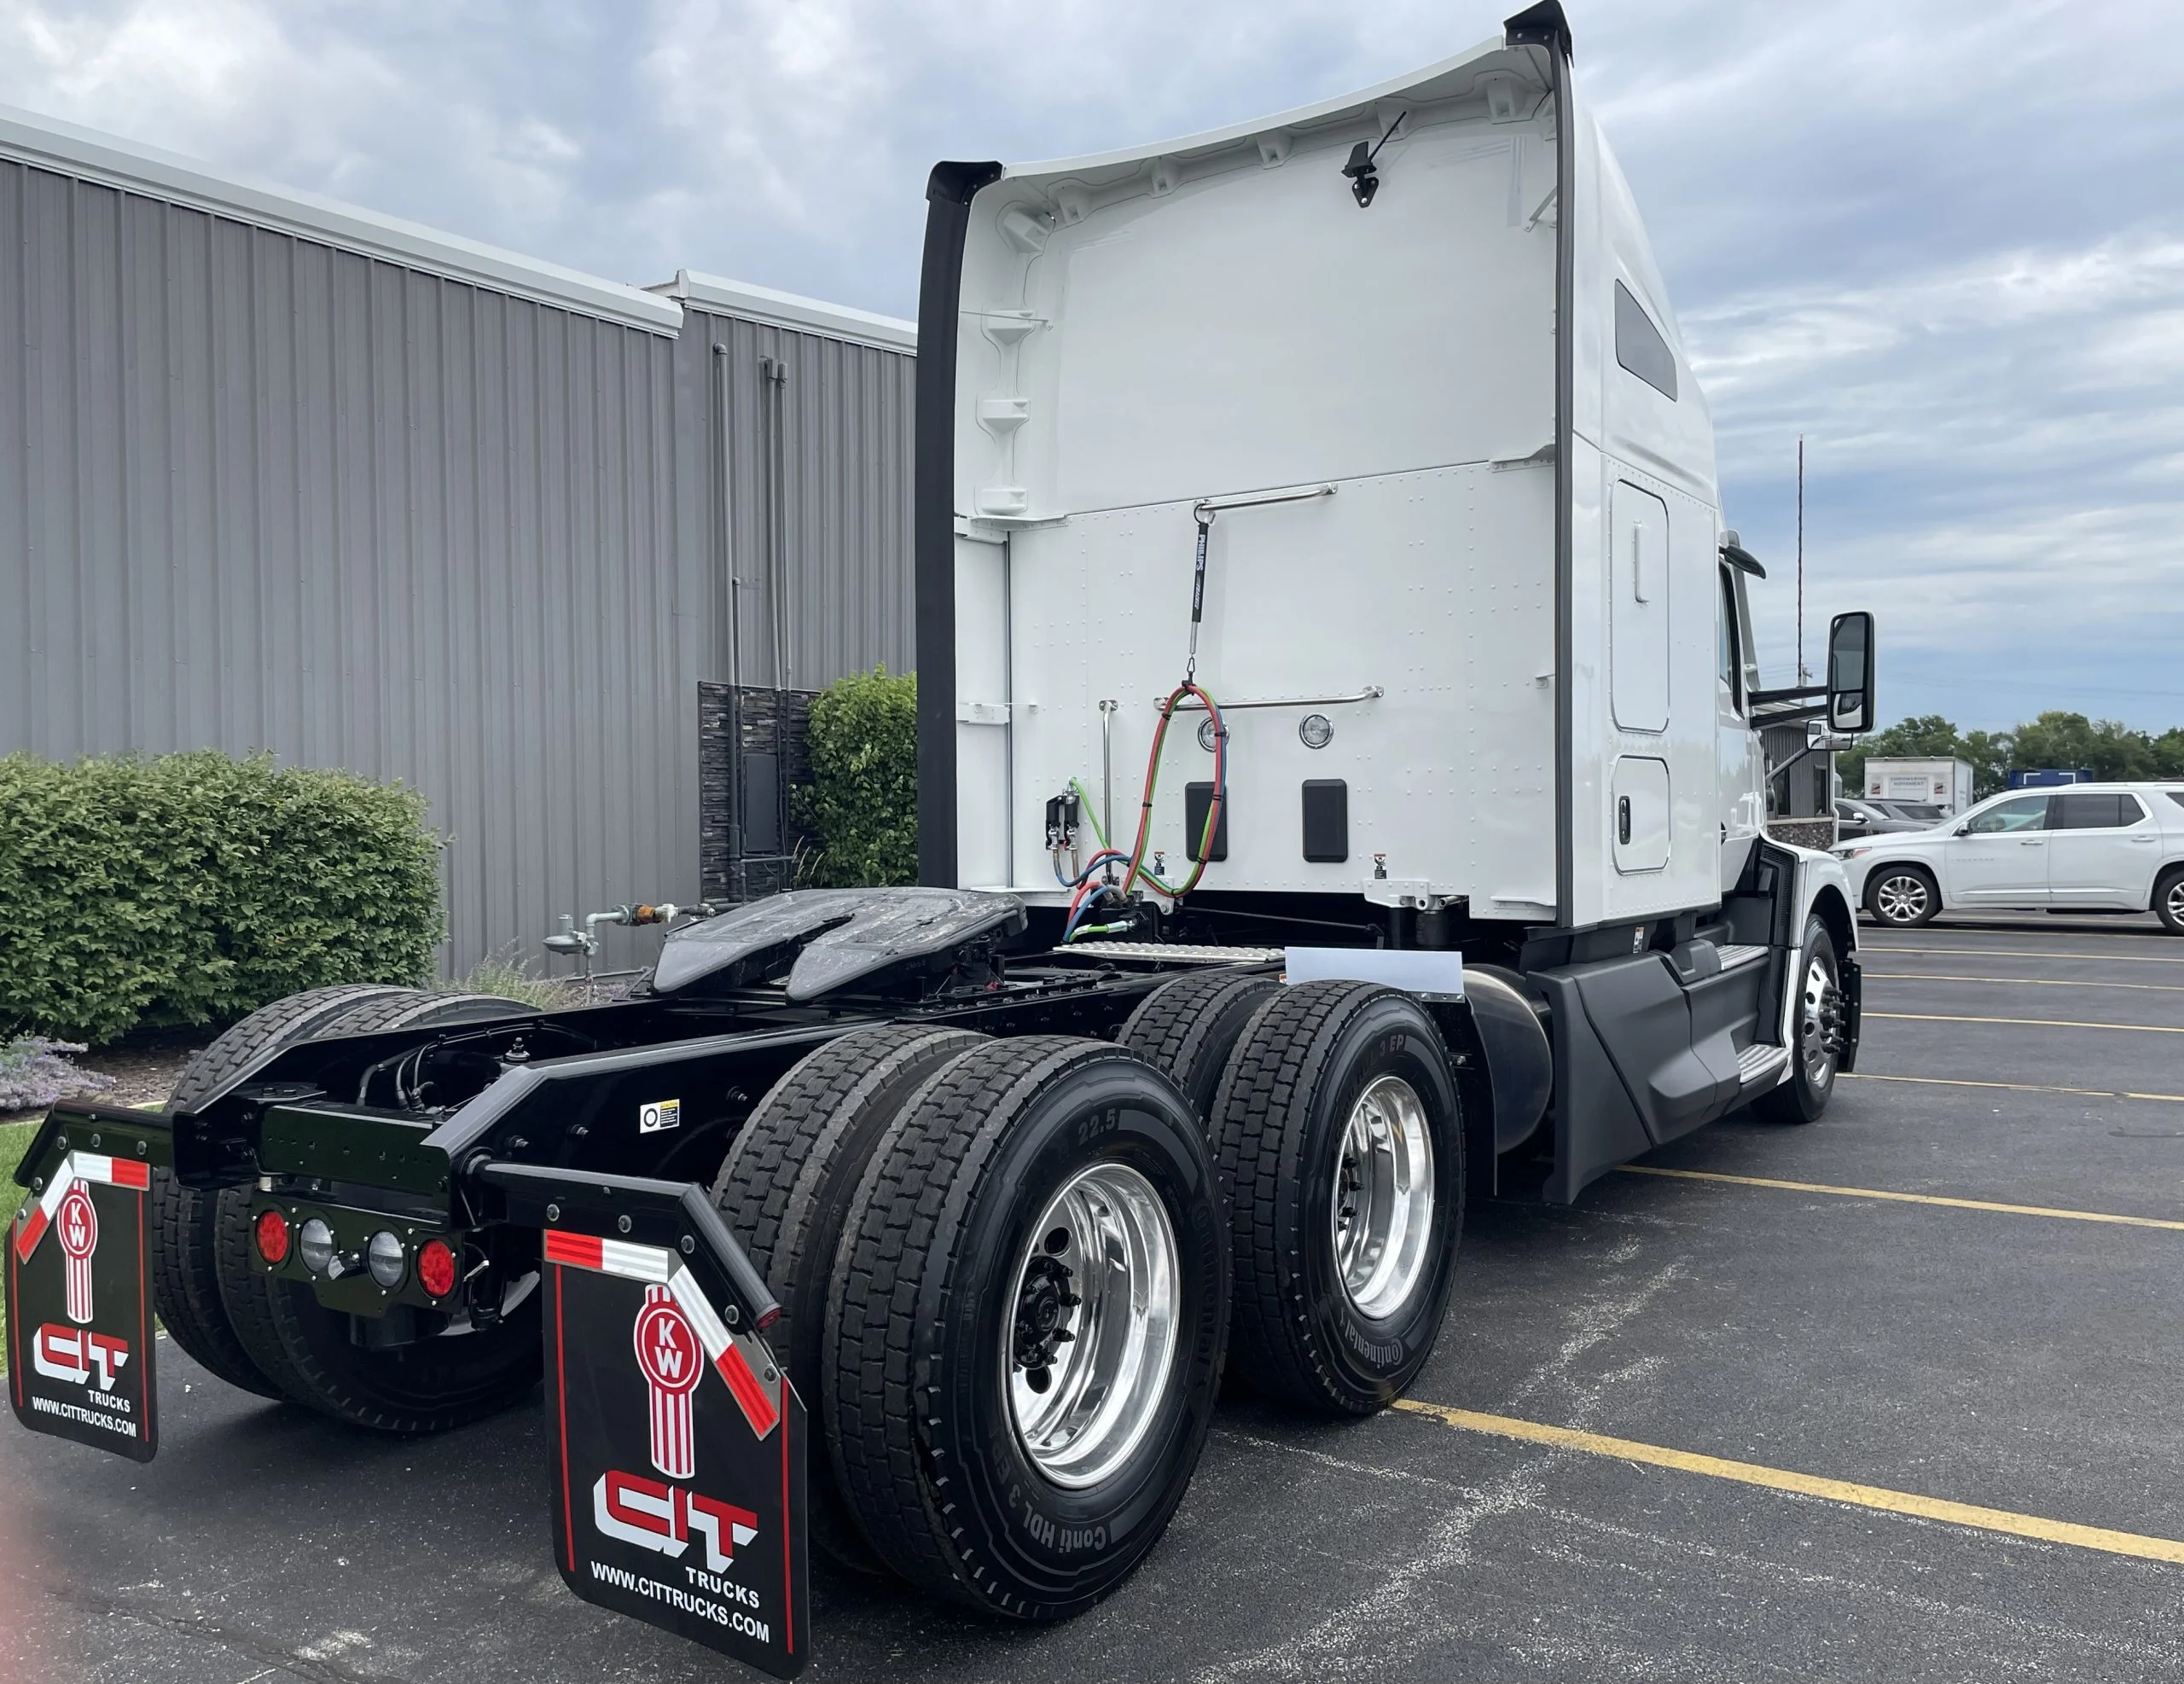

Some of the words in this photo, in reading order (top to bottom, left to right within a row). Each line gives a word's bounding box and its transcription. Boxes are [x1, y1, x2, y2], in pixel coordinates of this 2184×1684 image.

[1196, 534, 1205, 571] PHILLIPS
[1077, 1108, 1117, 1147] 22.5
[33, 1322, 129, 1391] CIT
[1345, 1320, 1403, 1369] Continental
[32, 1397, 137, 1437] WWW.CITTRUCKS.COM
[87, 1390, 131, 1413] TRUCKS
[1008, 1484, 1021, 1508] 3
[594, 1469, 759, 1574] CIT
[1024, 1501, 1055, 1549] HDL
[1059, 1525, 1107, 1553] Conti
[590, 1560, 770, 1643] WWW.CITTRUCKS.COM
[685, 1565, 759, 1609] TRUCKS
